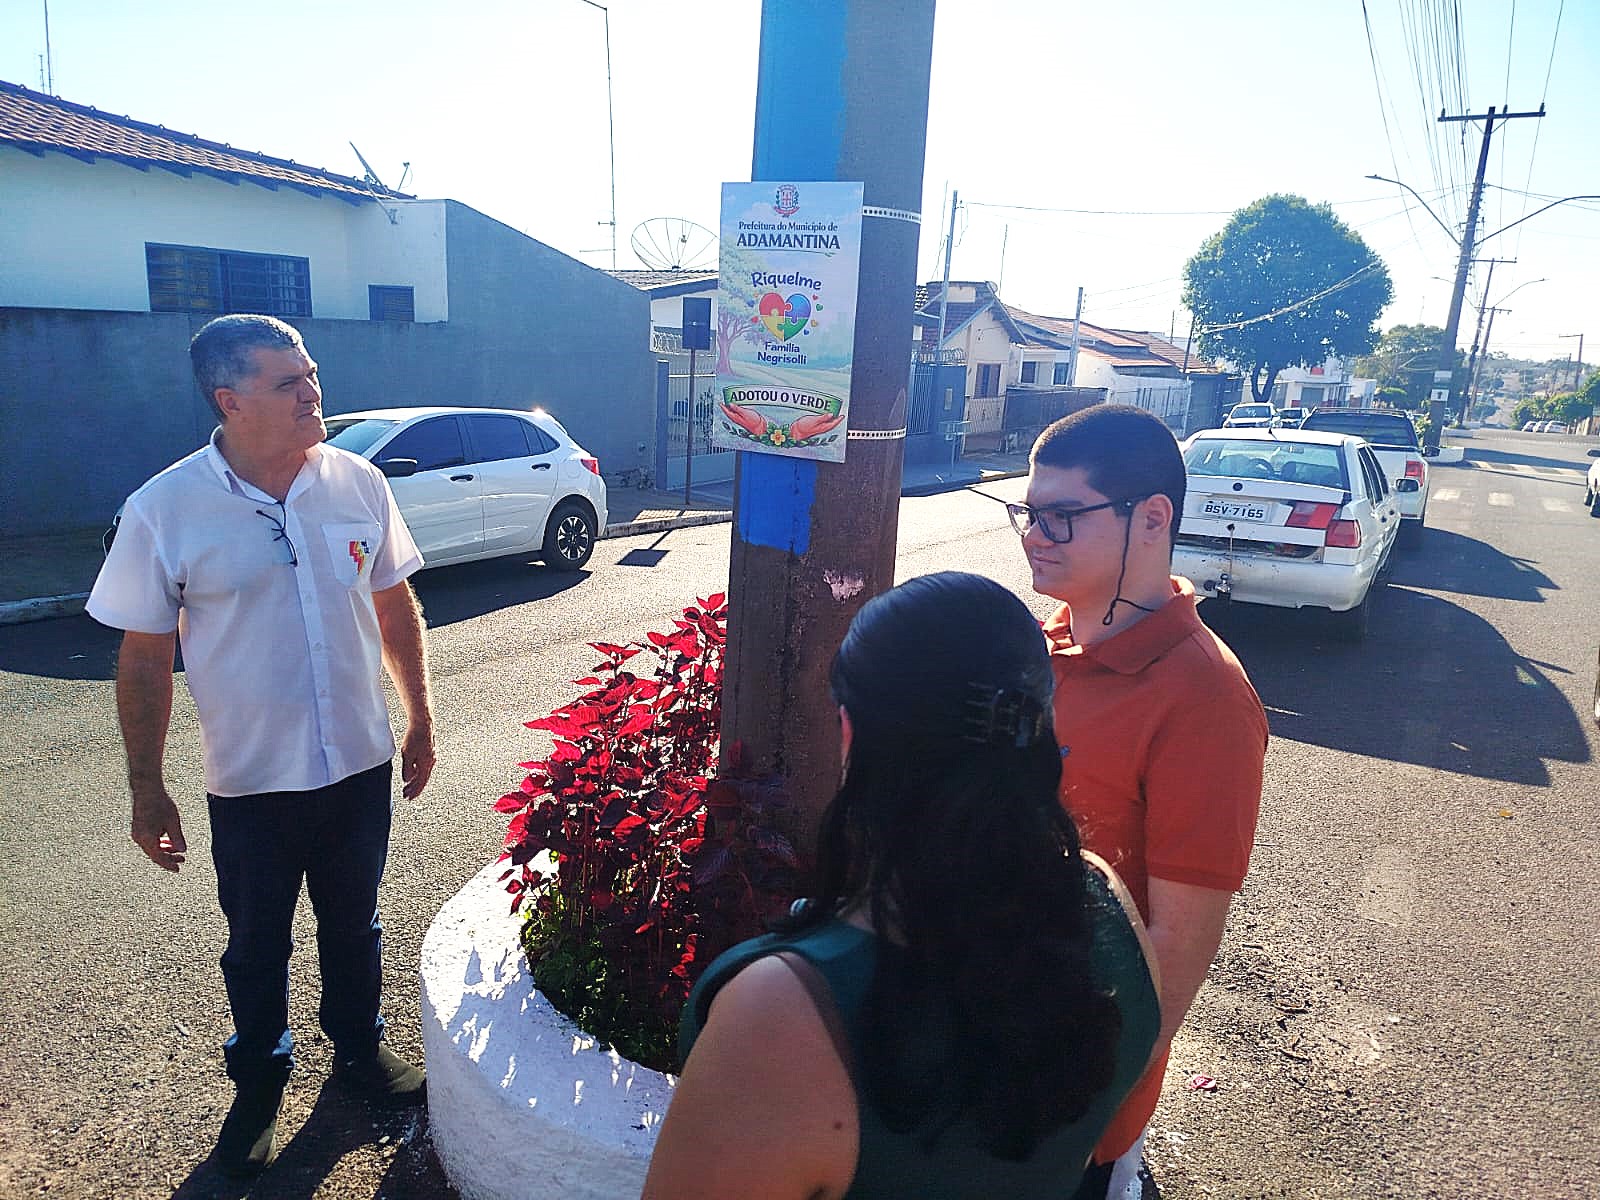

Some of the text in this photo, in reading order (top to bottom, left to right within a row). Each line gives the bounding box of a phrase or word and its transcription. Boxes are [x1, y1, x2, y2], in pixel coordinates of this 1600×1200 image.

[739, 222, 775, 231] Prefeitura
[777, 222, 787, 231] do
[827, 222, 838, 231] de
[737, 233, 840, 249] ADAMANTINA
[751, 272, 822, 290] Riquelme
[757, 352, 807, 365] Negrisolli
[730, 390, 832, 411] ADOTOU O VERDE
